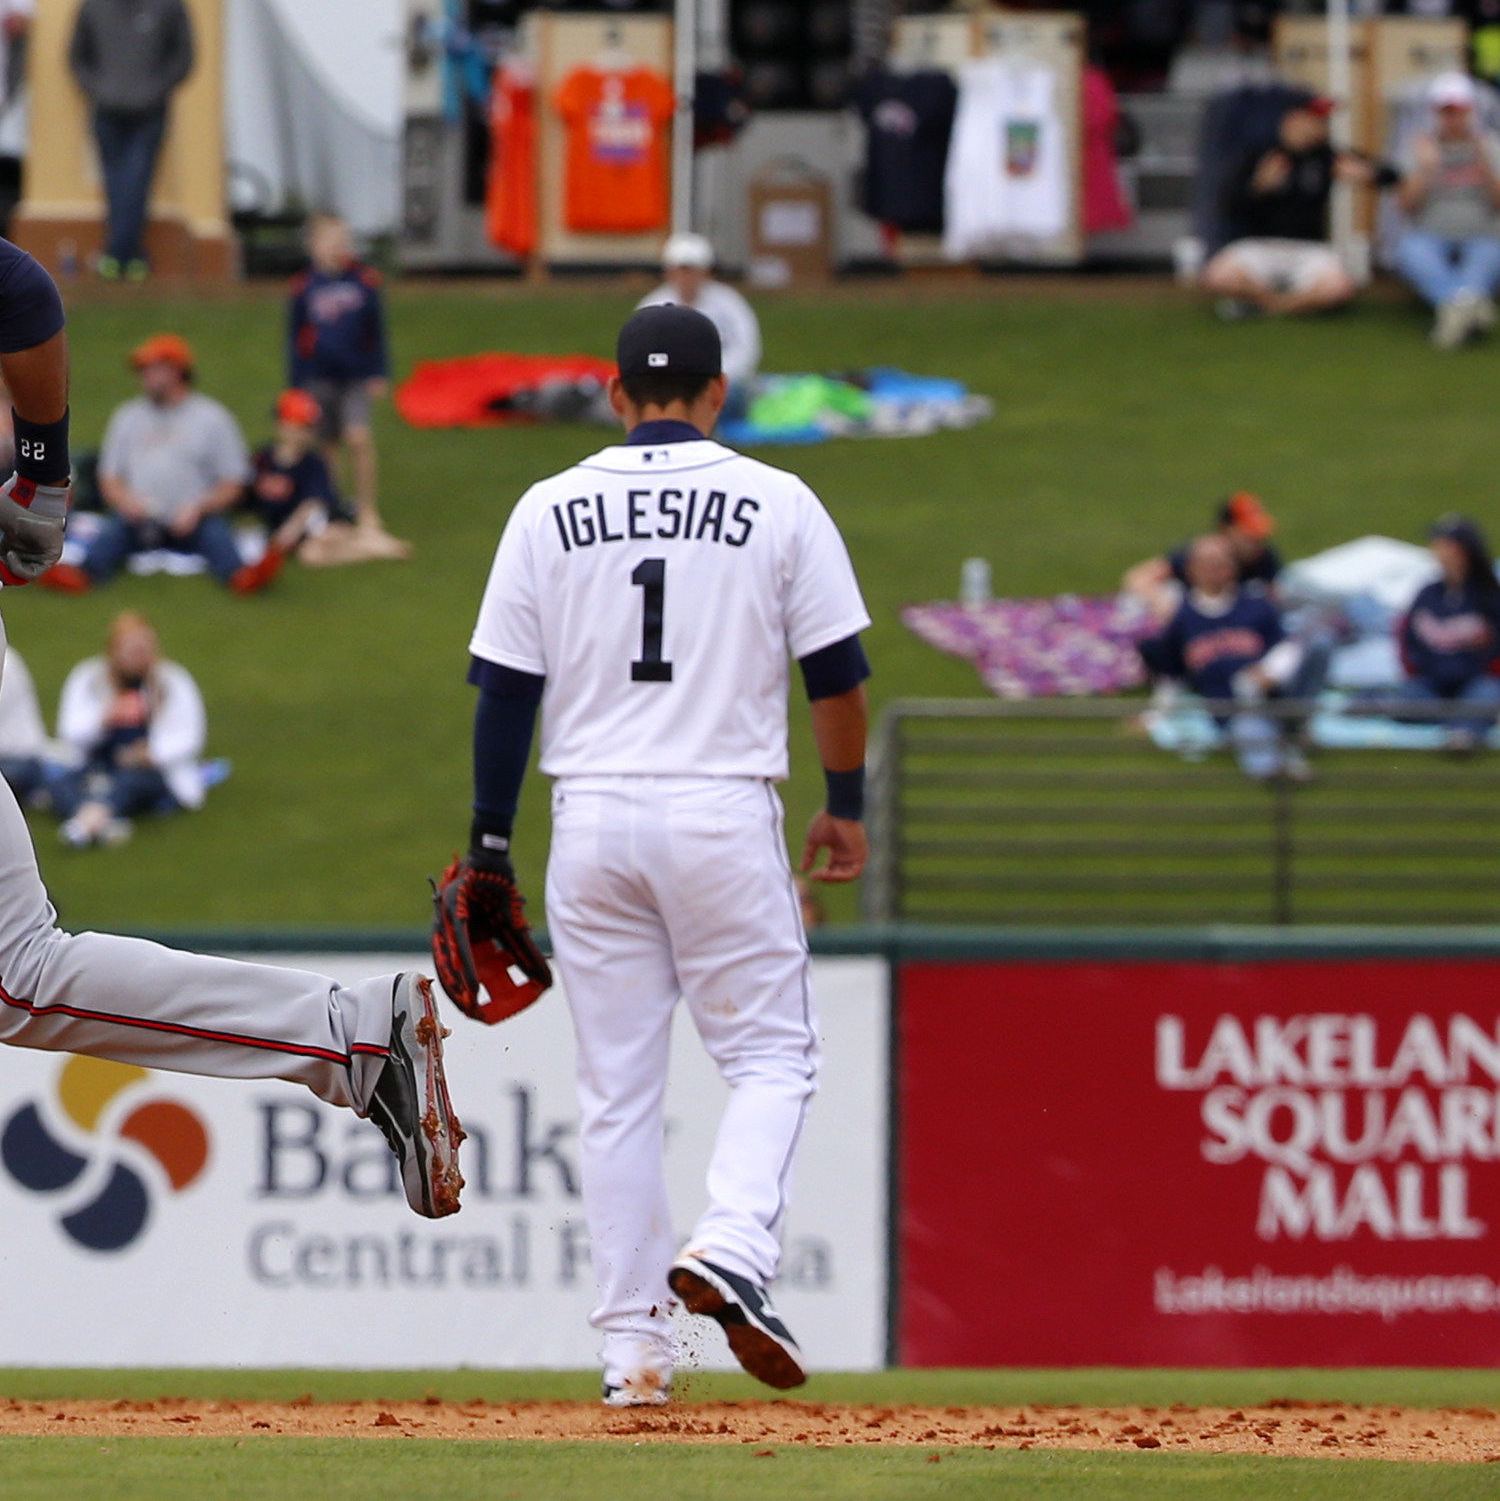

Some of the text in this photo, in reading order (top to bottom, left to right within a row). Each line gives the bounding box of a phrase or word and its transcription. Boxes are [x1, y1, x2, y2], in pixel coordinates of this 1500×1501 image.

[20, 437, 45, 461] 22
[552, 490, 760, 552] IGLESIAS
[630, 557, 673, 682] 1
[1154, 1014, 1500, 1089] LAKELAN
[1256, 1164, 1484, 1240] MALL
[248, 1218, 531, 1290] Central
